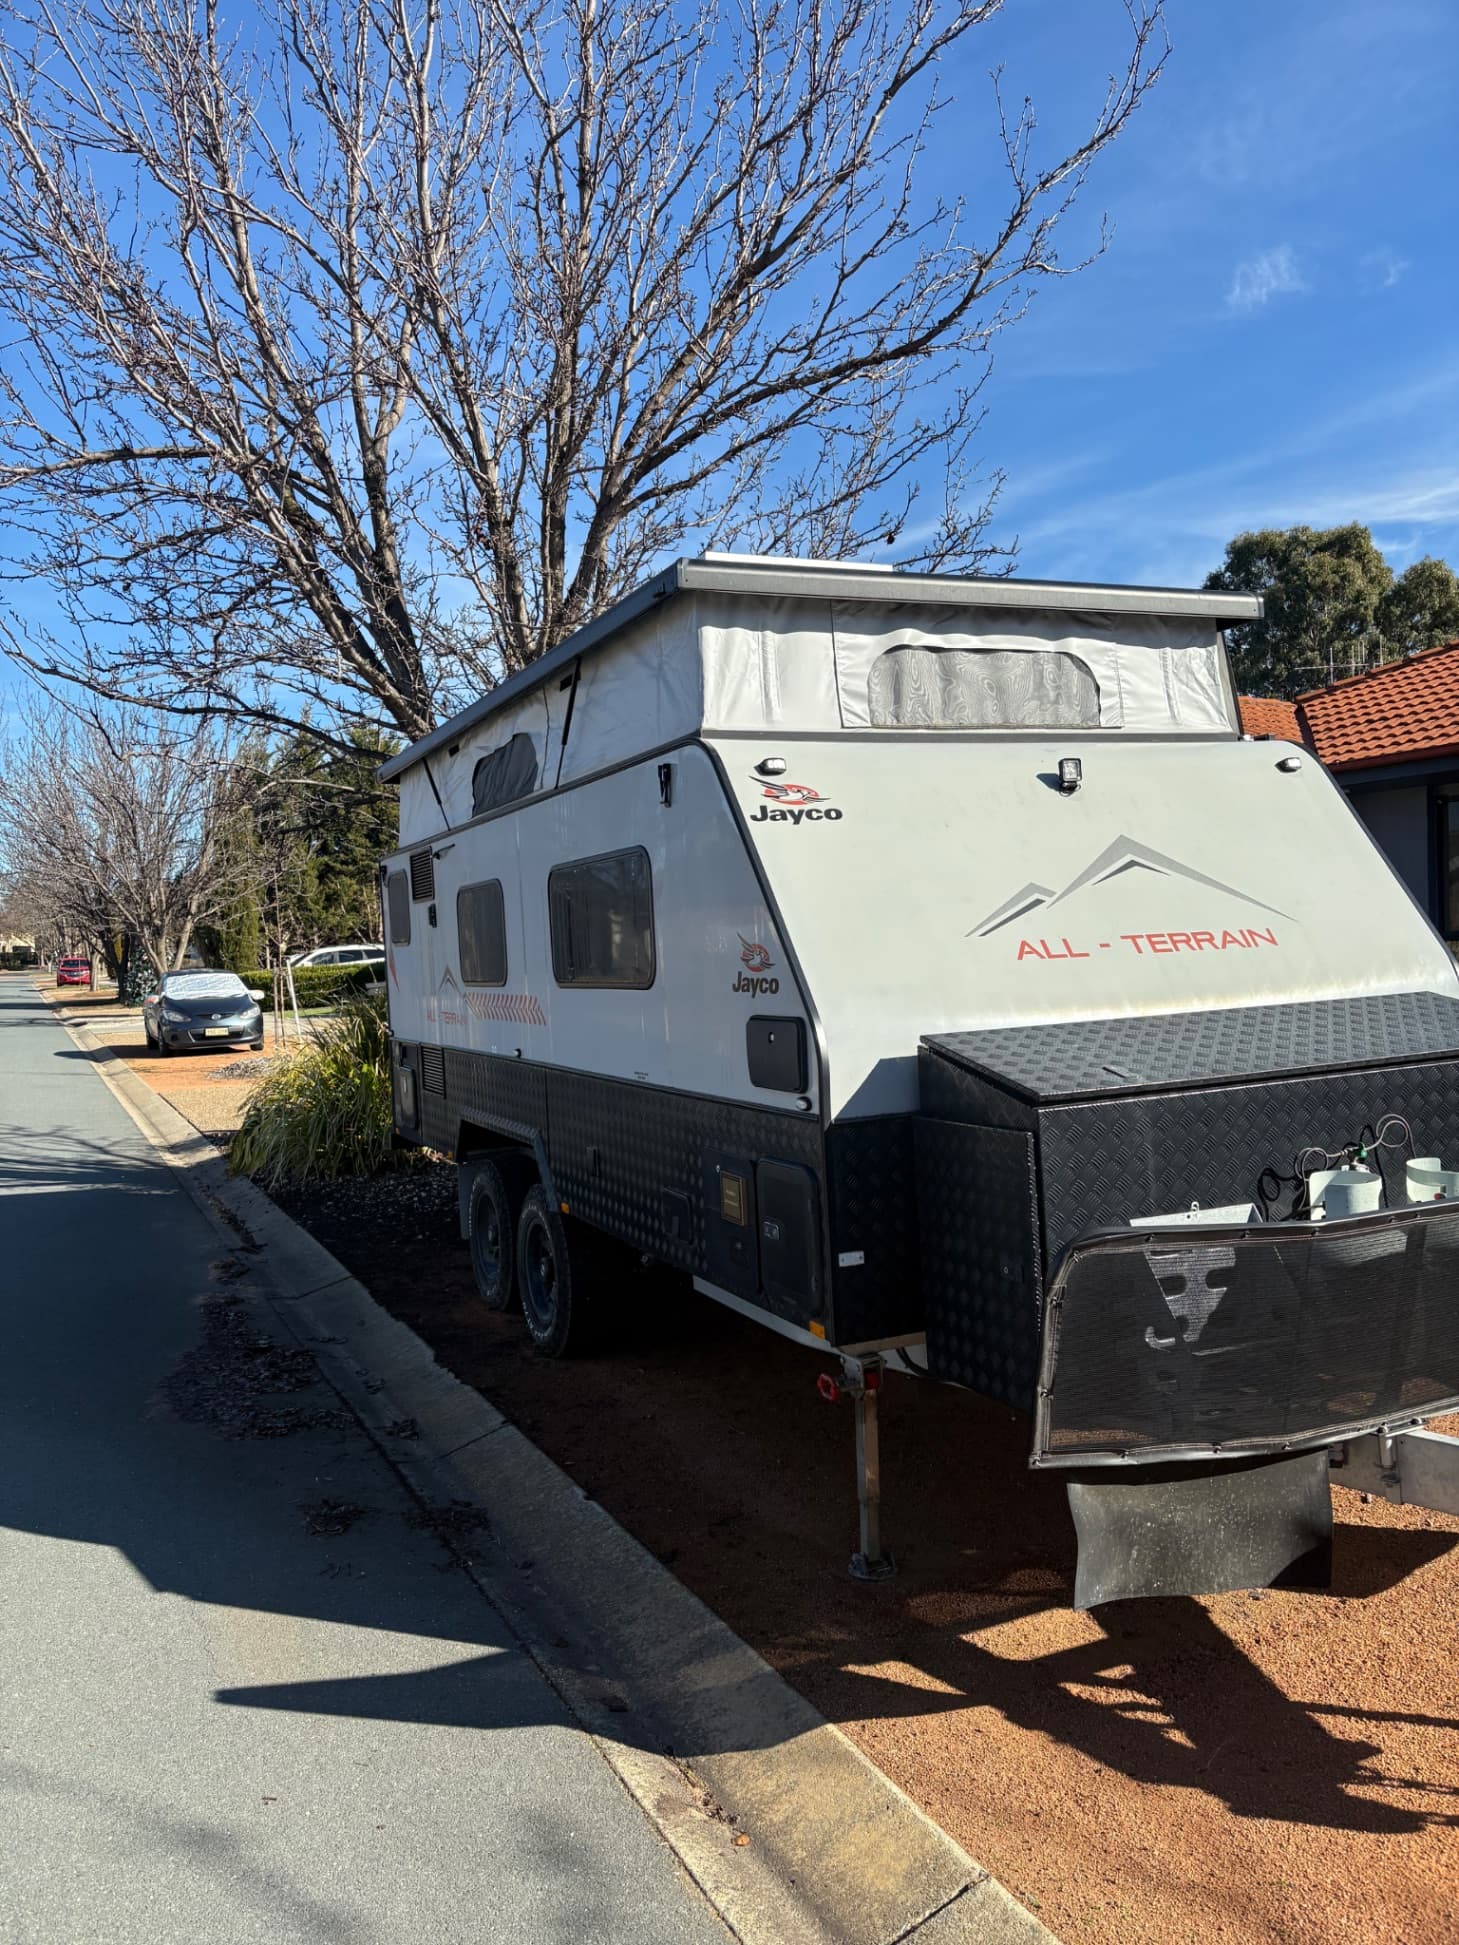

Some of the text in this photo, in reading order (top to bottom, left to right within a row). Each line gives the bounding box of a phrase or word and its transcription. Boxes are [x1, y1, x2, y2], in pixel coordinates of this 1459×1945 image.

[750, 805, 843, 825] Jayco
[1017, 938, 1090, 961] ALL
[1120, 928, 1279, 954] TERRAIN
[732, 971, 780, 998] Jayco
